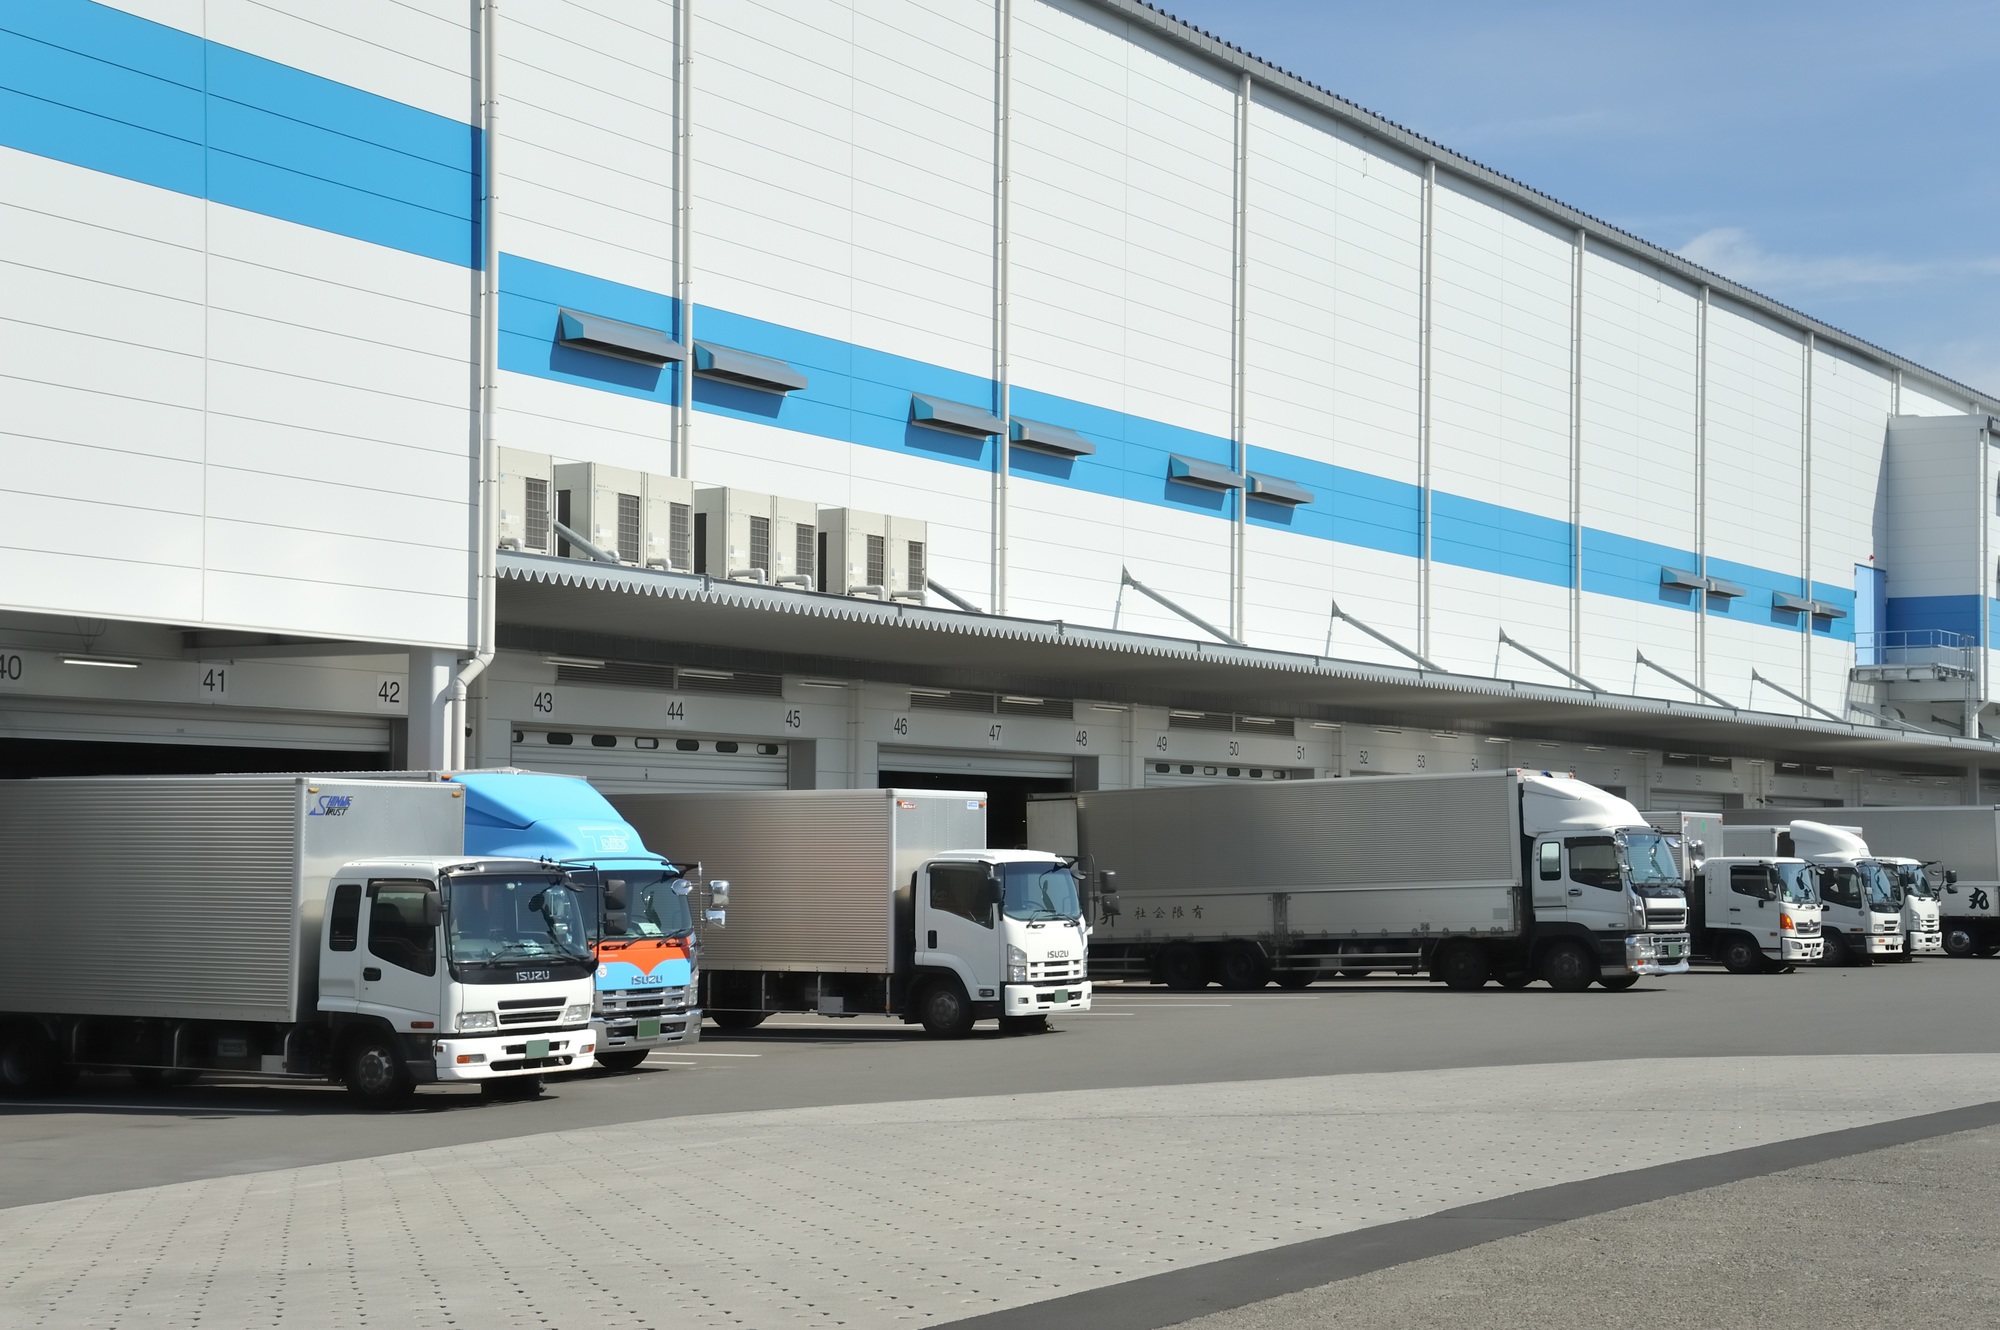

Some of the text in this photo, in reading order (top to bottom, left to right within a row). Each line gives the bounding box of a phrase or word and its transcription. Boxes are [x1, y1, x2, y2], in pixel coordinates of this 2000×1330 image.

[0, 655, 22, 681] 40
[203, 669, 226, 692] 41
[378, 681, 400, 703] 42
[533, 692, 553, 713] 43
[667, 702, 685, 721] 44
[785, 710, 801, 729] 45
[893, 717, 908, 736] 46
[988, 724, 1002, 741] 47
[1075, 730, 1088, 747] 48
[1156, 736, 1168, 752] 49
[1229, 741, 1239, 757] 50
[1296, 746, 1305, 760] 51
[1359, 750, 1369, 765] 52
[1417, 754, 1426, 769] 53
[1471, 758, 1479, 772] 54
[1613, 768, 1621, 781] 57
[325, 807, 349, 817] TRUST
[1047, 950, 1069, 959] ISUZU
[516, 970, 550, 982] ISUZU
[631, 975, 663, 986] ISUZU
